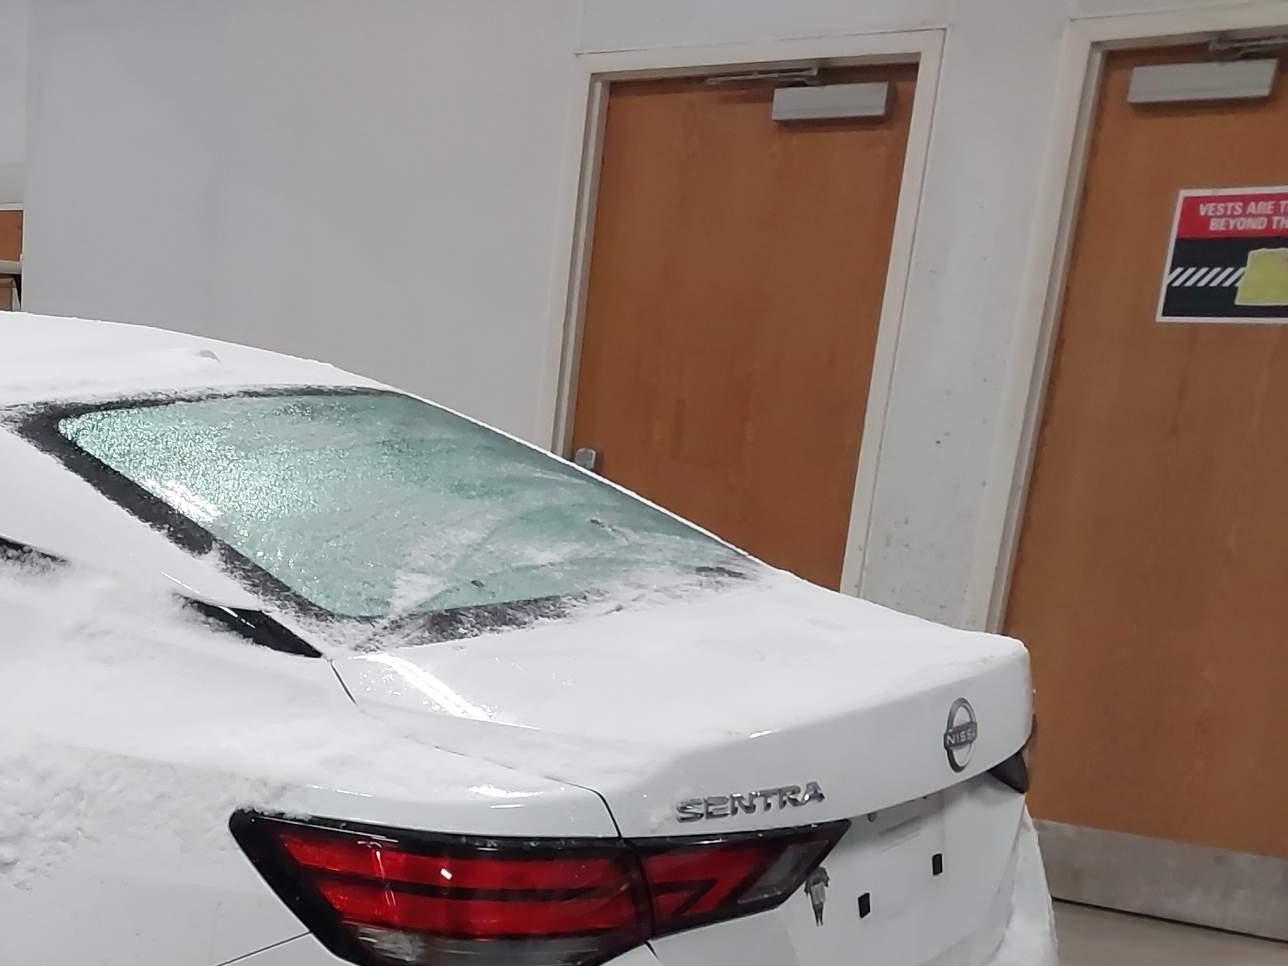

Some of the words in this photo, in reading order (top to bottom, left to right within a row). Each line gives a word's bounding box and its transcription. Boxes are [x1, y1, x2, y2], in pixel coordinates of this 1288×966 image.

[1199, 201, 1244, 217] VESTS
[1246, 200, 1275, 215] ARE
[1209, 216, 1268, 231] BEYOND
[946, 727, 976, 745] NISS
[676, 781, 826, 824] SENTRA
